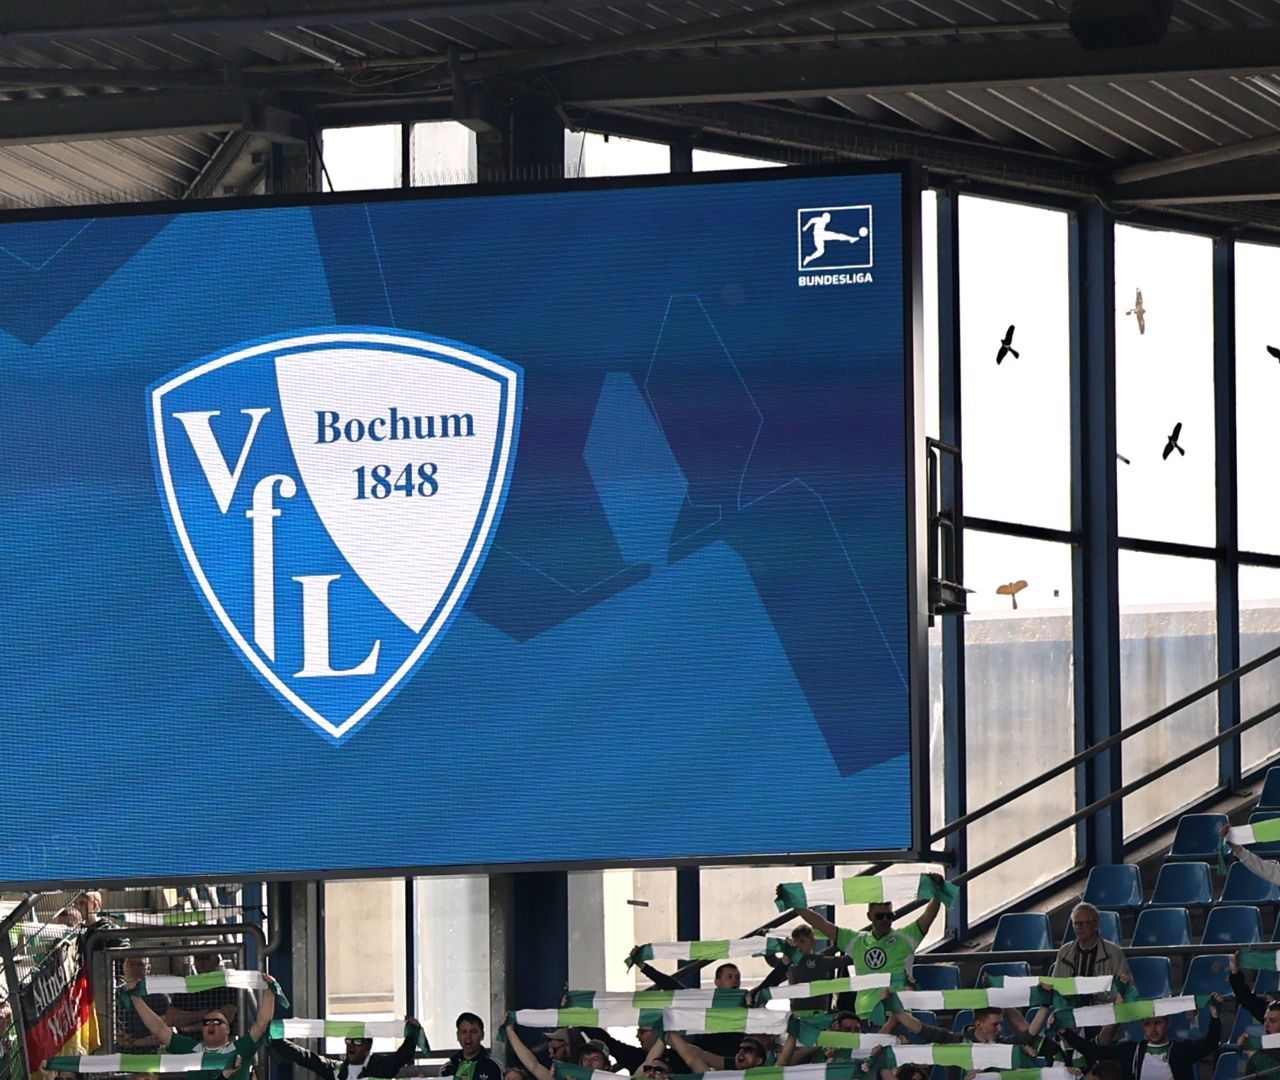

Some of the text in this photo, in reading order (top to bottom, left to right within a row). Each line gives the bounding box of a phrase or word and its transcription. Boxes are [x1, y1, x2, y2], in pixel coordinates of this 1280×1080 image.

[798, 272, 873, 287] BUNDESLIGA
[314, 407, 476, 445] Bochum
[351, 462, 440, 500] 1848
